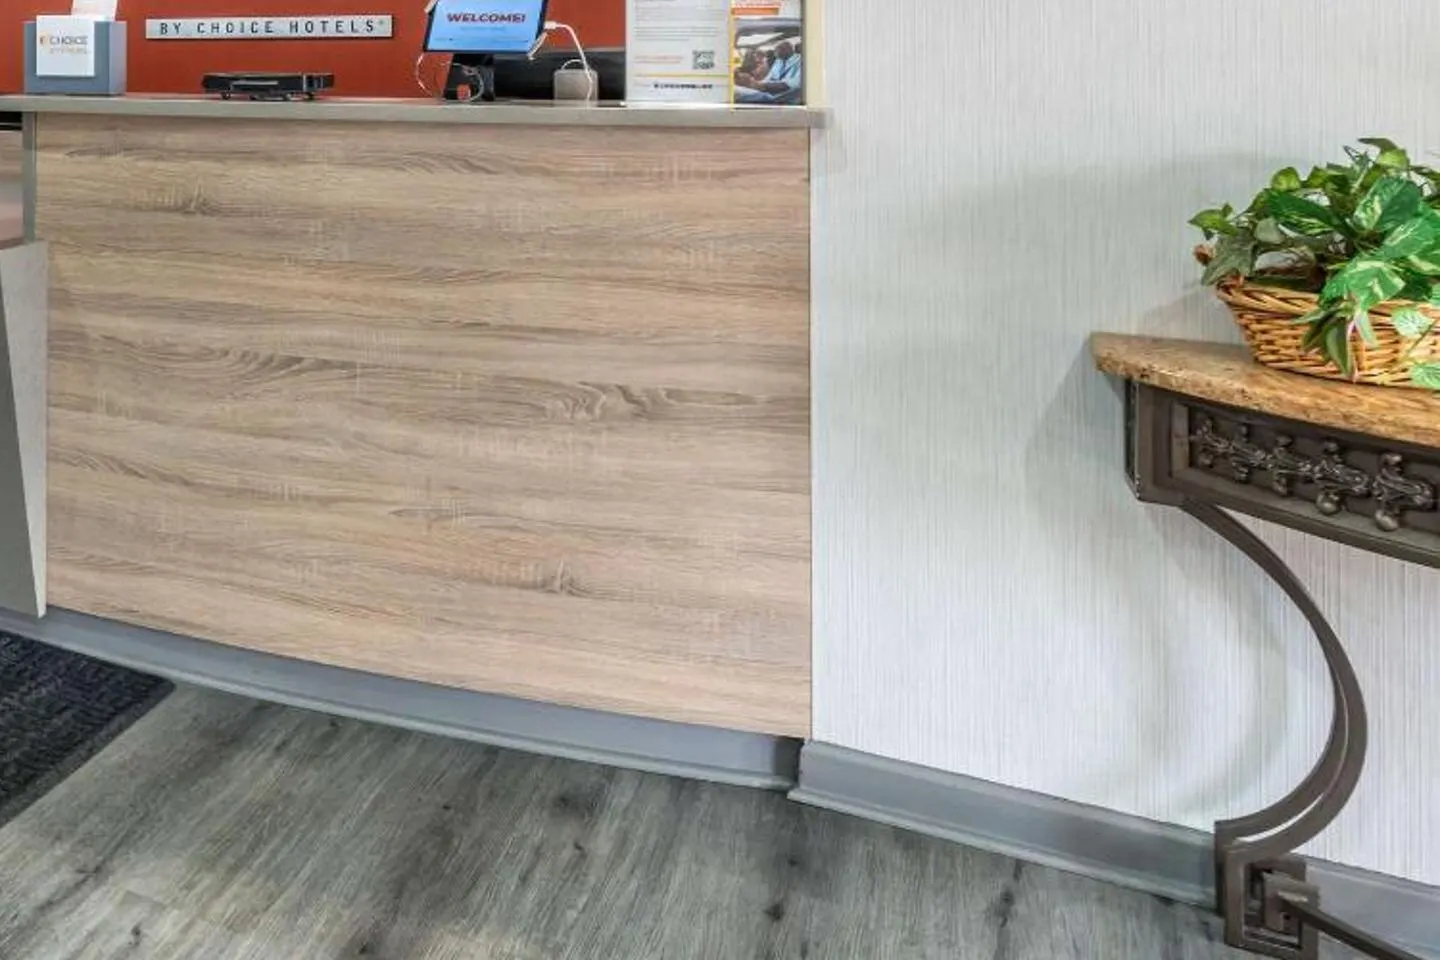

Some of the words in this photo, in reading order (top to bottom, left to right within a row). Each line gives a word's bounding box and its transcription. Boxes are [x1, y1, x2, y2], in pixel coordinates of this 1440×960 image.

[446, 12, 527, 24] WELCOME!
[159, 22, 182, 36] BY
[196, 20, 274, 35] CHOICE
